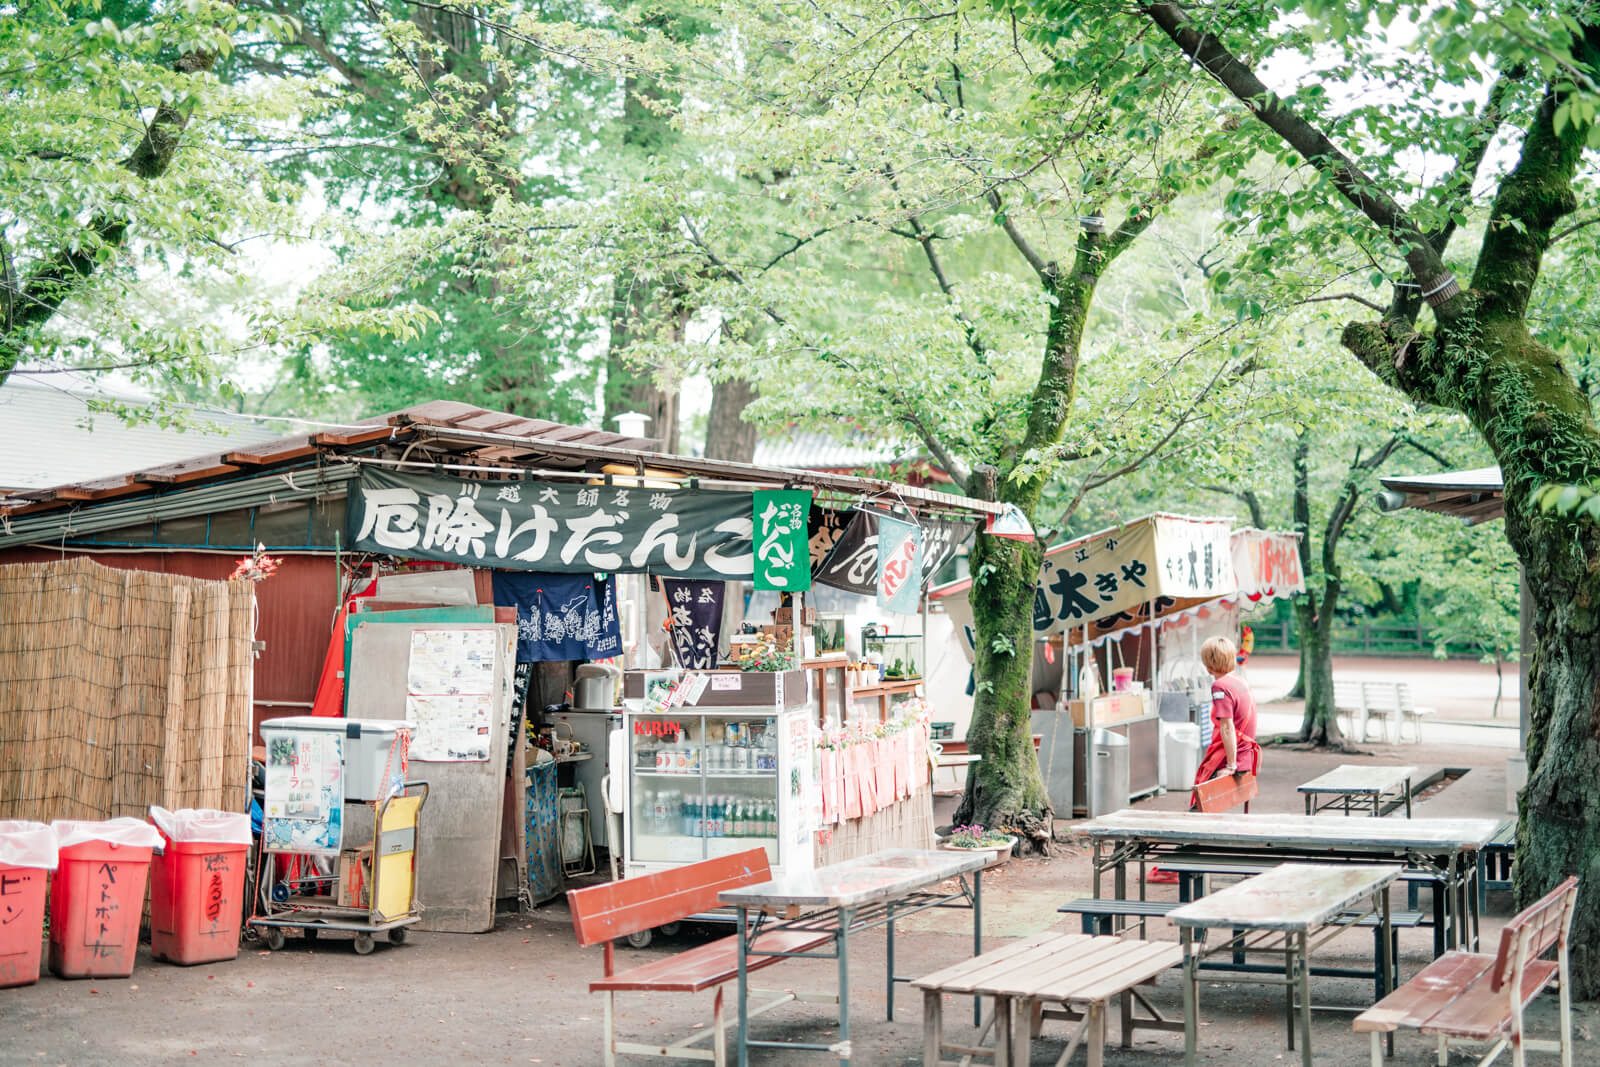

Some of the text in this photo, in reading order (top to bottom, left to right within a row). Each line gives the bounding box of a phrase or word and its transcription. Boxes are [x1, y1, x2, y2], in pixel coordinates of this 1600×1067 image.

[459, 483, 673, 510] 川越大師名物
[758, 500, 795, 587] だんご
[634, 720, 680, 735] KIRIN
[95, 863, 119, 958] ペットボトル
